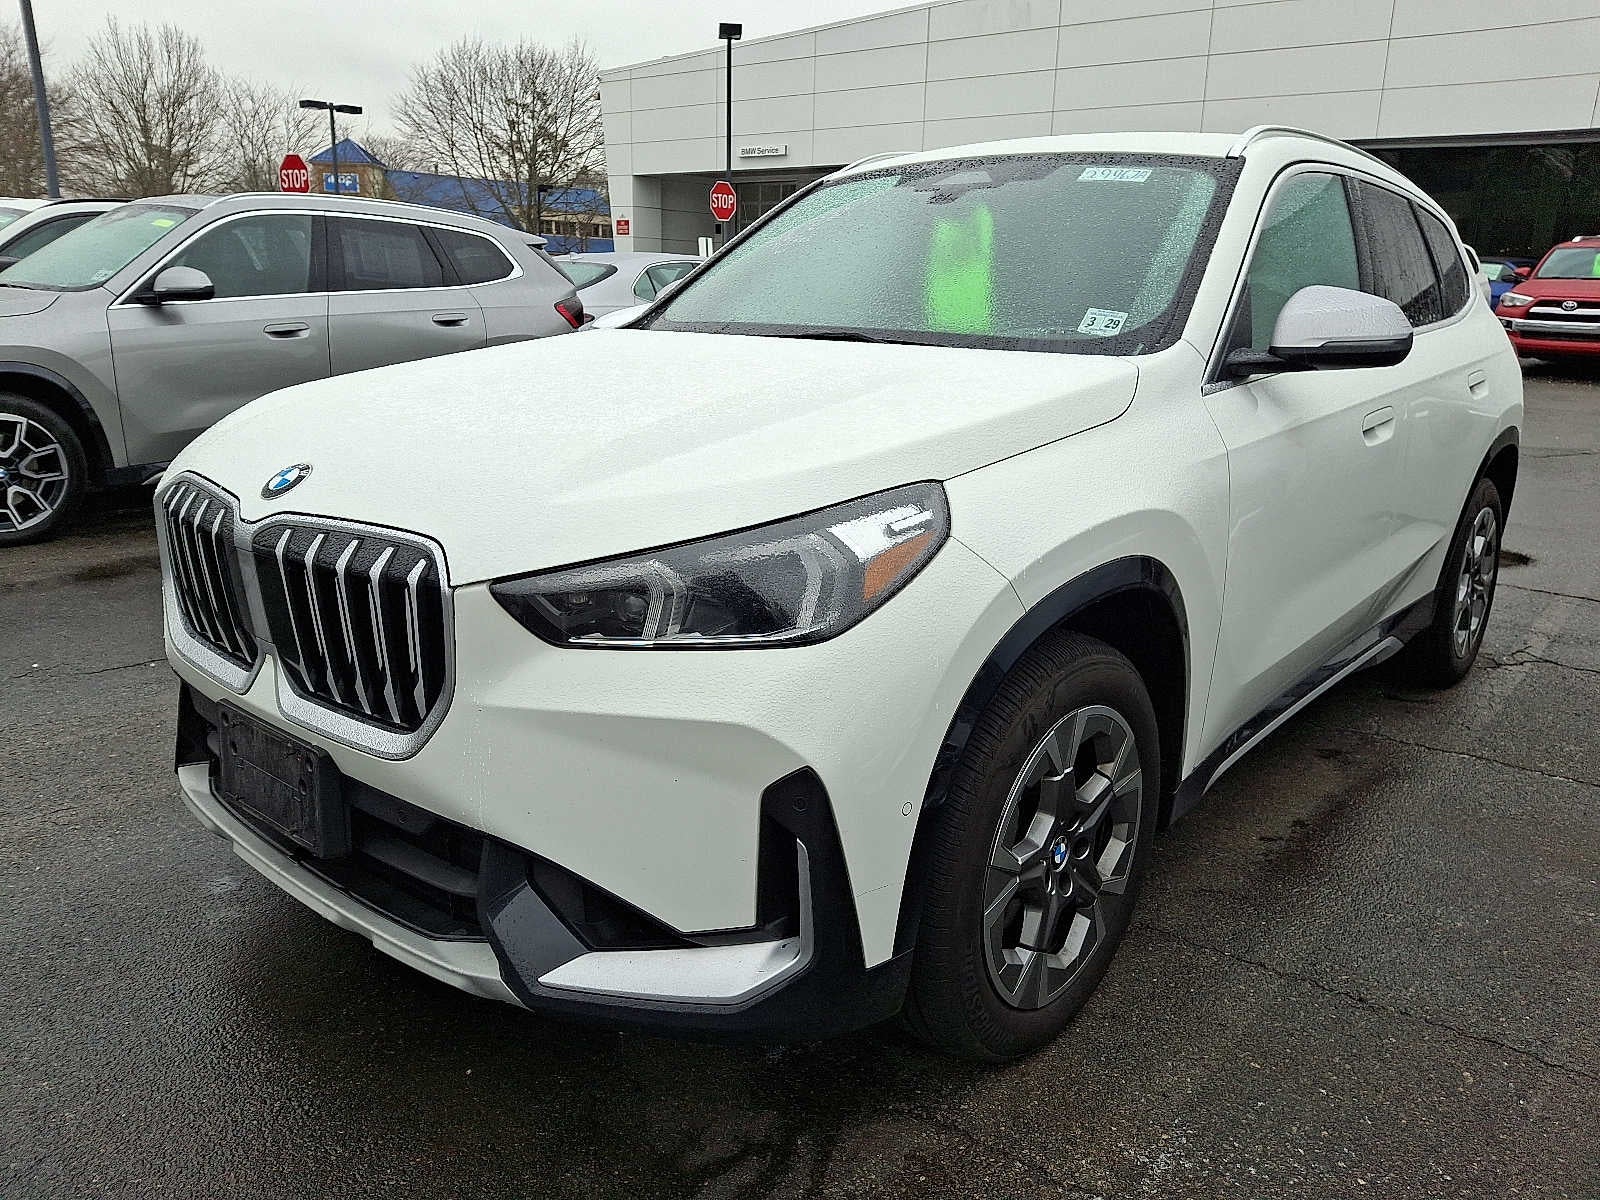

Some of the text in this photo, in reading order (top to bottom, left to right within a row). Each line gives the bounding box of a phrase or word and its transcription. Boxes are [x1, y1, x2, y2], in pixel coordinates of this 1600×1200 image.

[281, 169, 308, 189] STOP
[712, 193, 734, 209] STOP
[1086, 317, 1121, 330] 3 29
